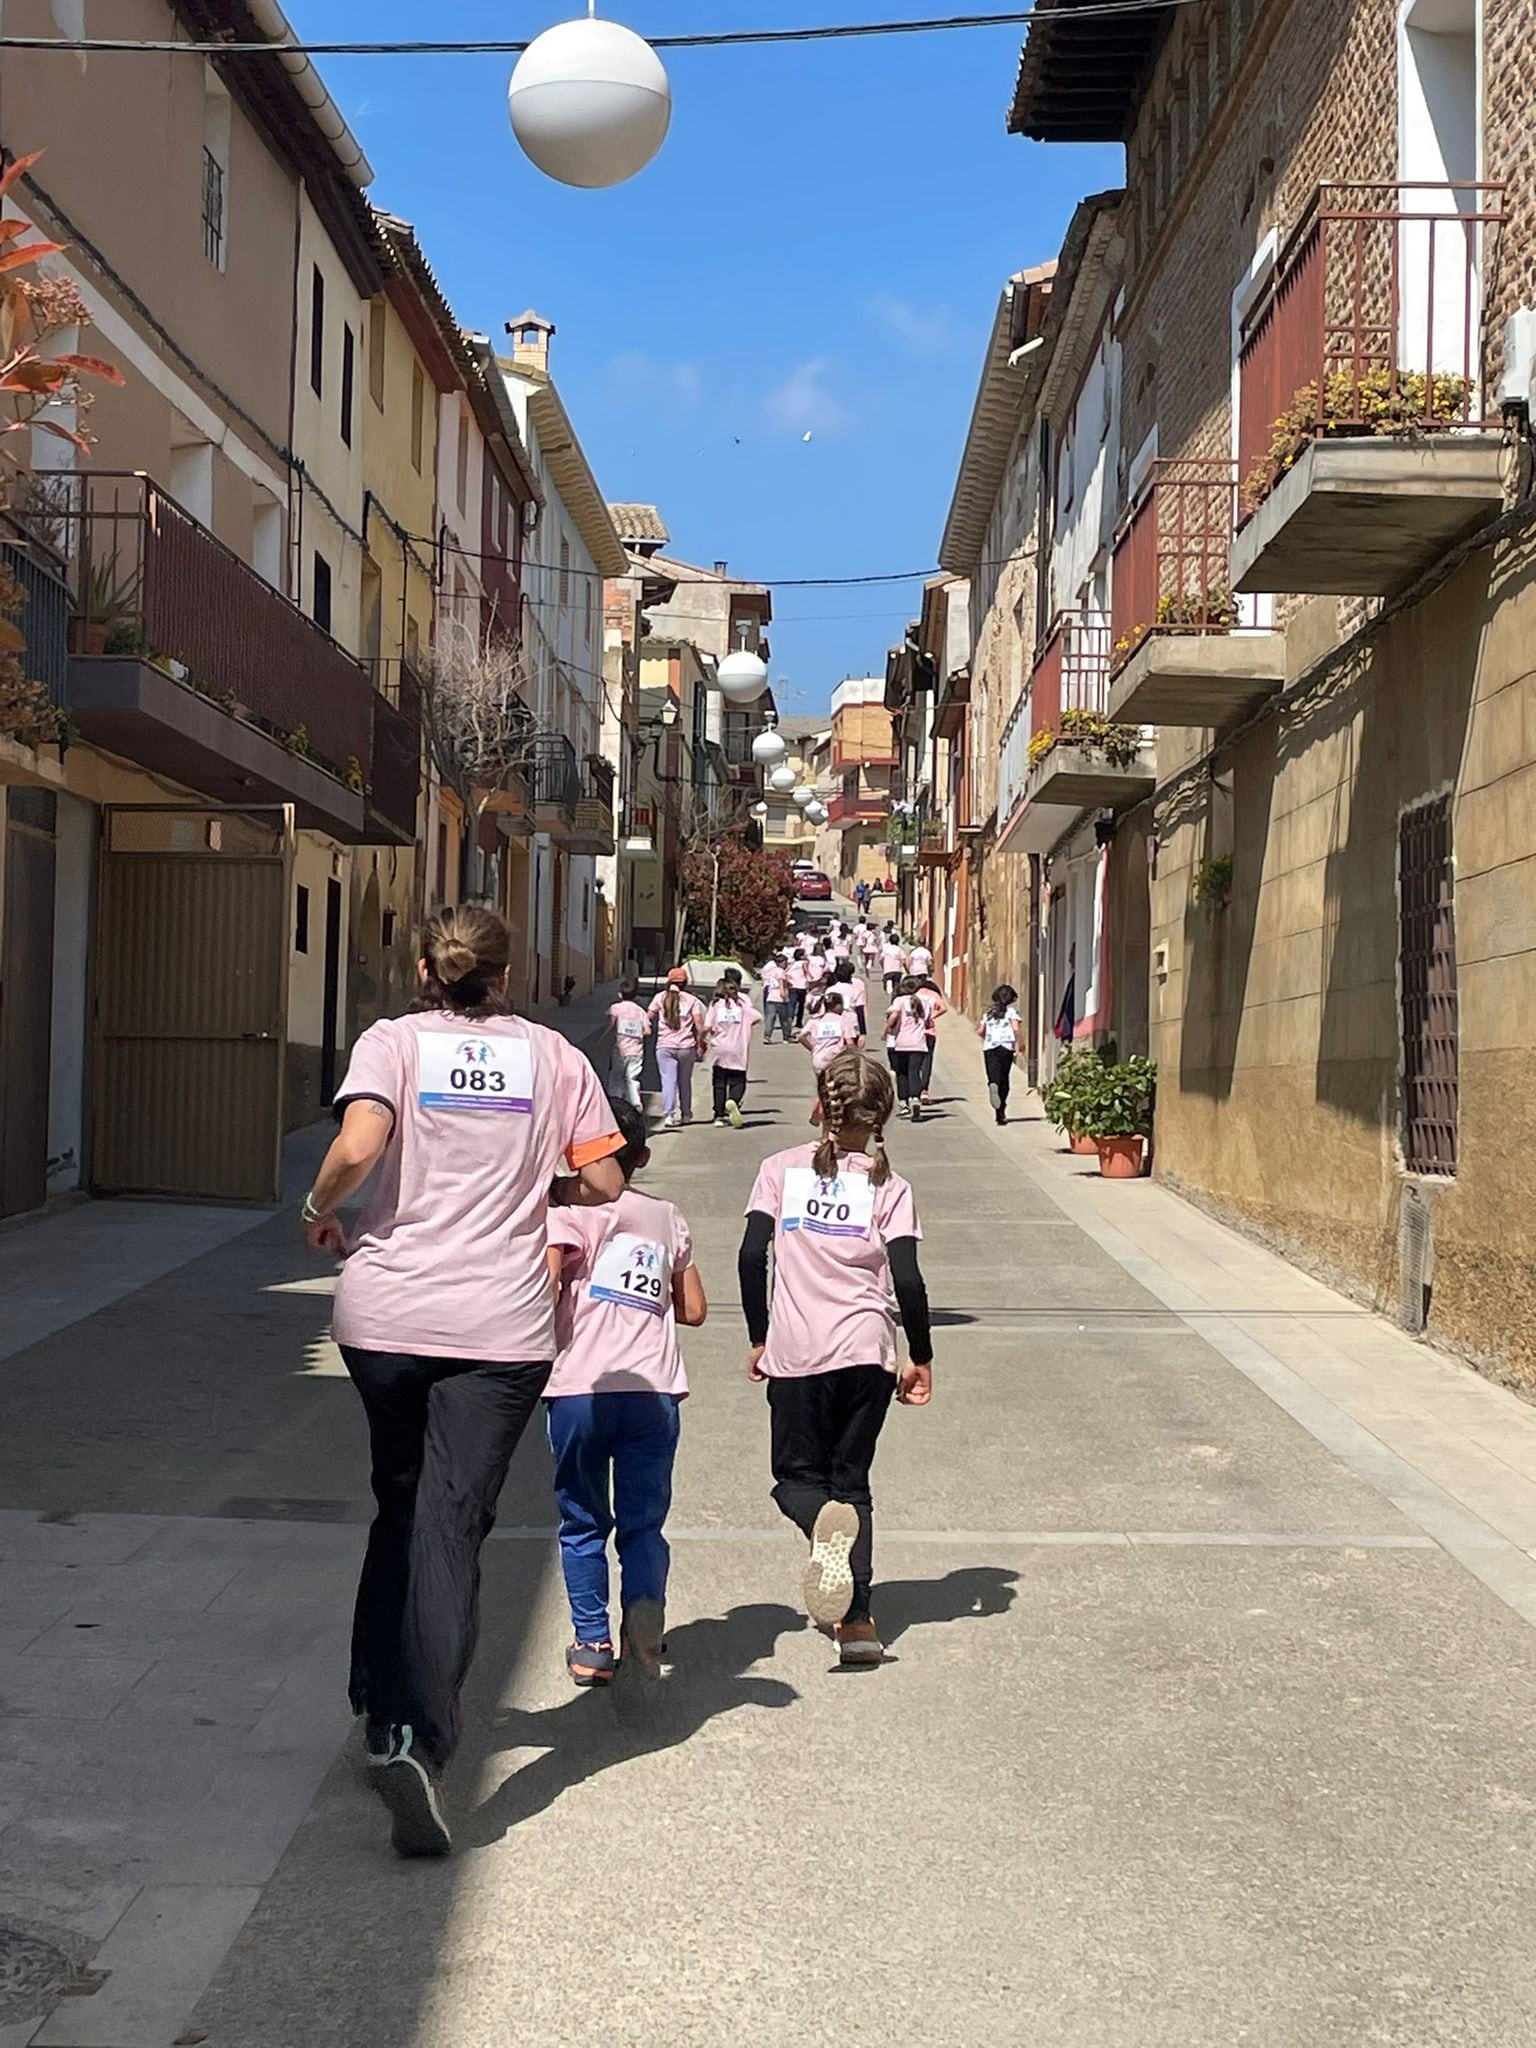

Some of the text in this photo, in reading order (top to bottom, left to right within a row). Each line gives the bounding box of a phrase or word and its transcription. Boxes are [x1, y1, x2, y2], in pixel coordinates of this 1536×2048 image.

[450, 1068, 506, 1092] 083
[806, 1199, 850, 1221] 070
[620, 1270, 661, 1298] 129
